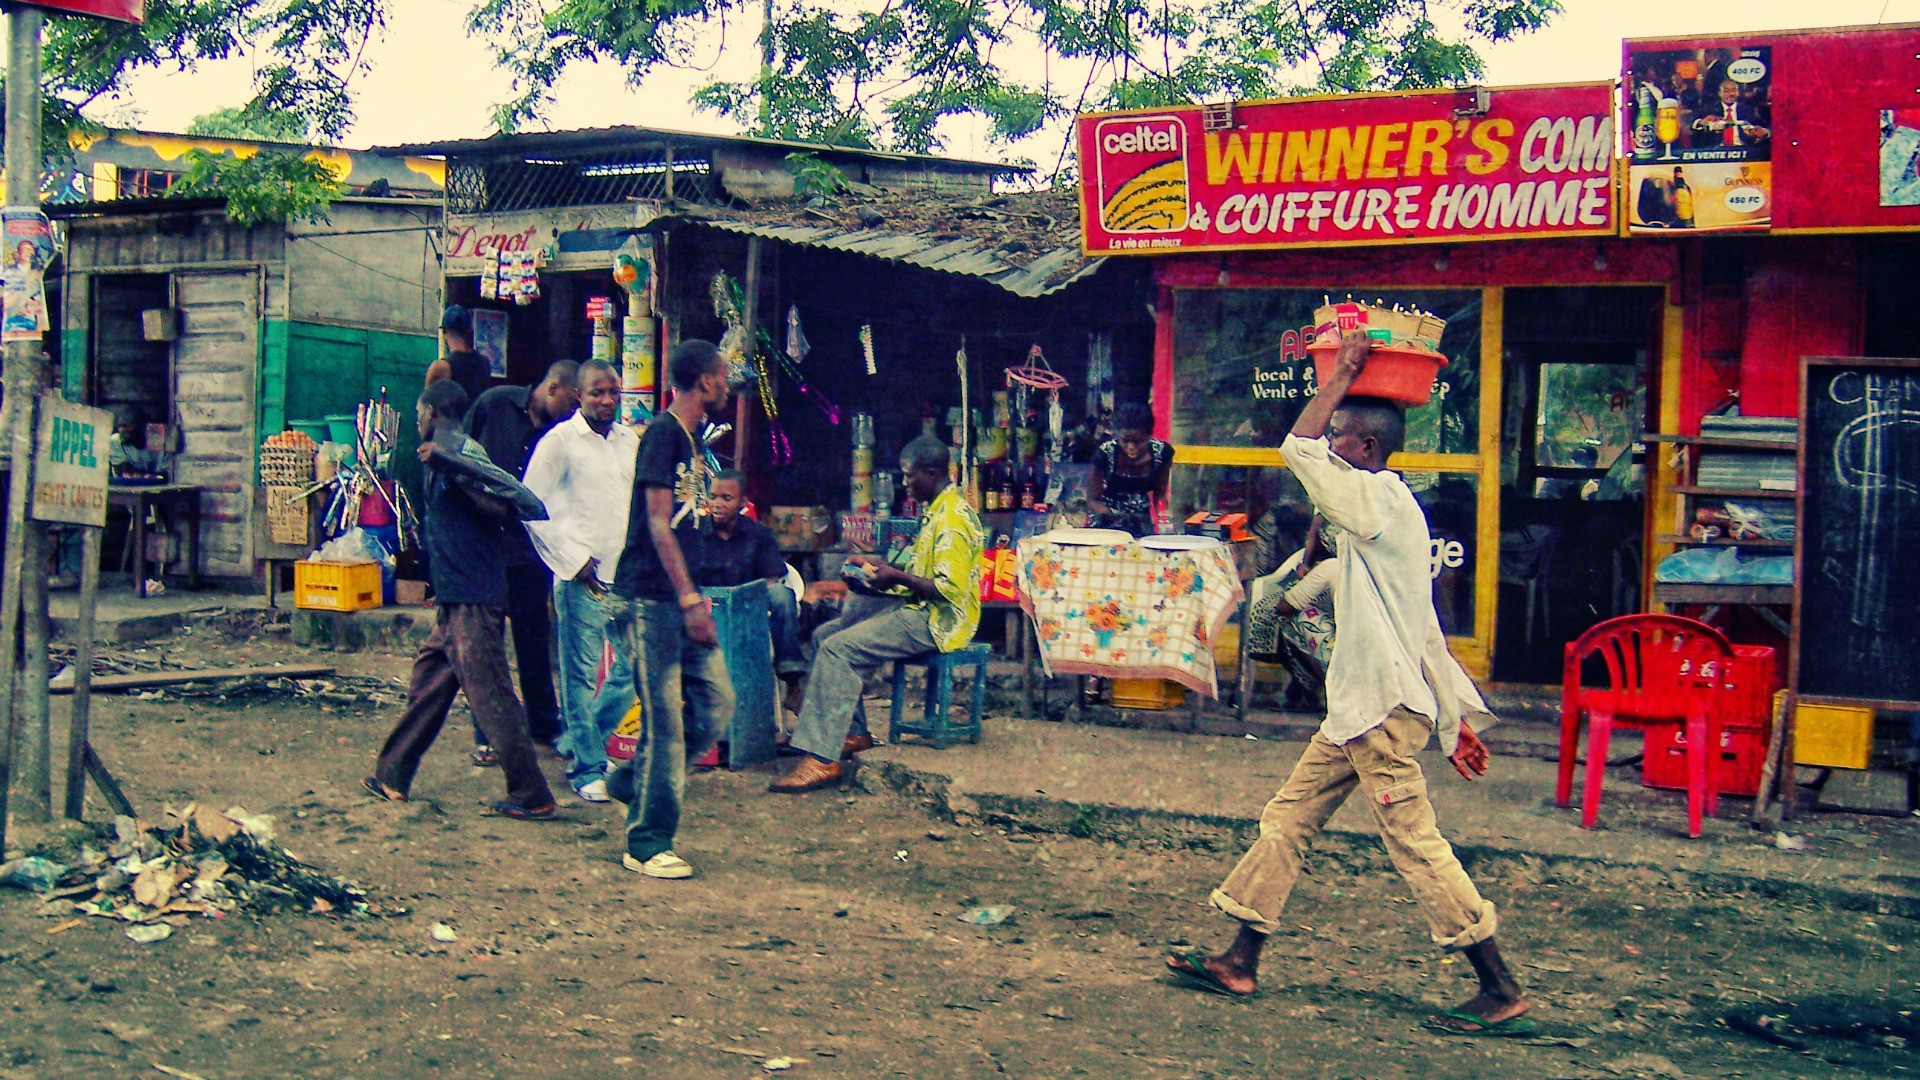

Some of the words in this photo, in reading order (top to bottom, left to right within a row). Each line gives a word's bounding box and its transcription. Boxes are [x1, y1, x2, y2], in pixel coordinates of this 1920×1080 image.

[1102, 123, 1178, 154] celtel
[1203, 118, 1515, 186] WINNER'S
[1519, 116, 1613, 174] COM
[1683, 152, 1696, 160] EN
[1697, 151, 1727, 160] VENTE
[1188, 201, 1211, 232] &
[1215, 184, 1423, 235] COIFFURE
[1425, 177, 1610, 230] HOMME
[1108, 238, 1122, 250] La
[1122, 237, 1138, 250] vie
[1138, 239, 1151, 249] en
[1150, 237, 1182, 249] mieux
[1254, 366, 1294, 382] local
[1302, 366, 1315, 381] &
[50, 415, 98, 469] APPEL
